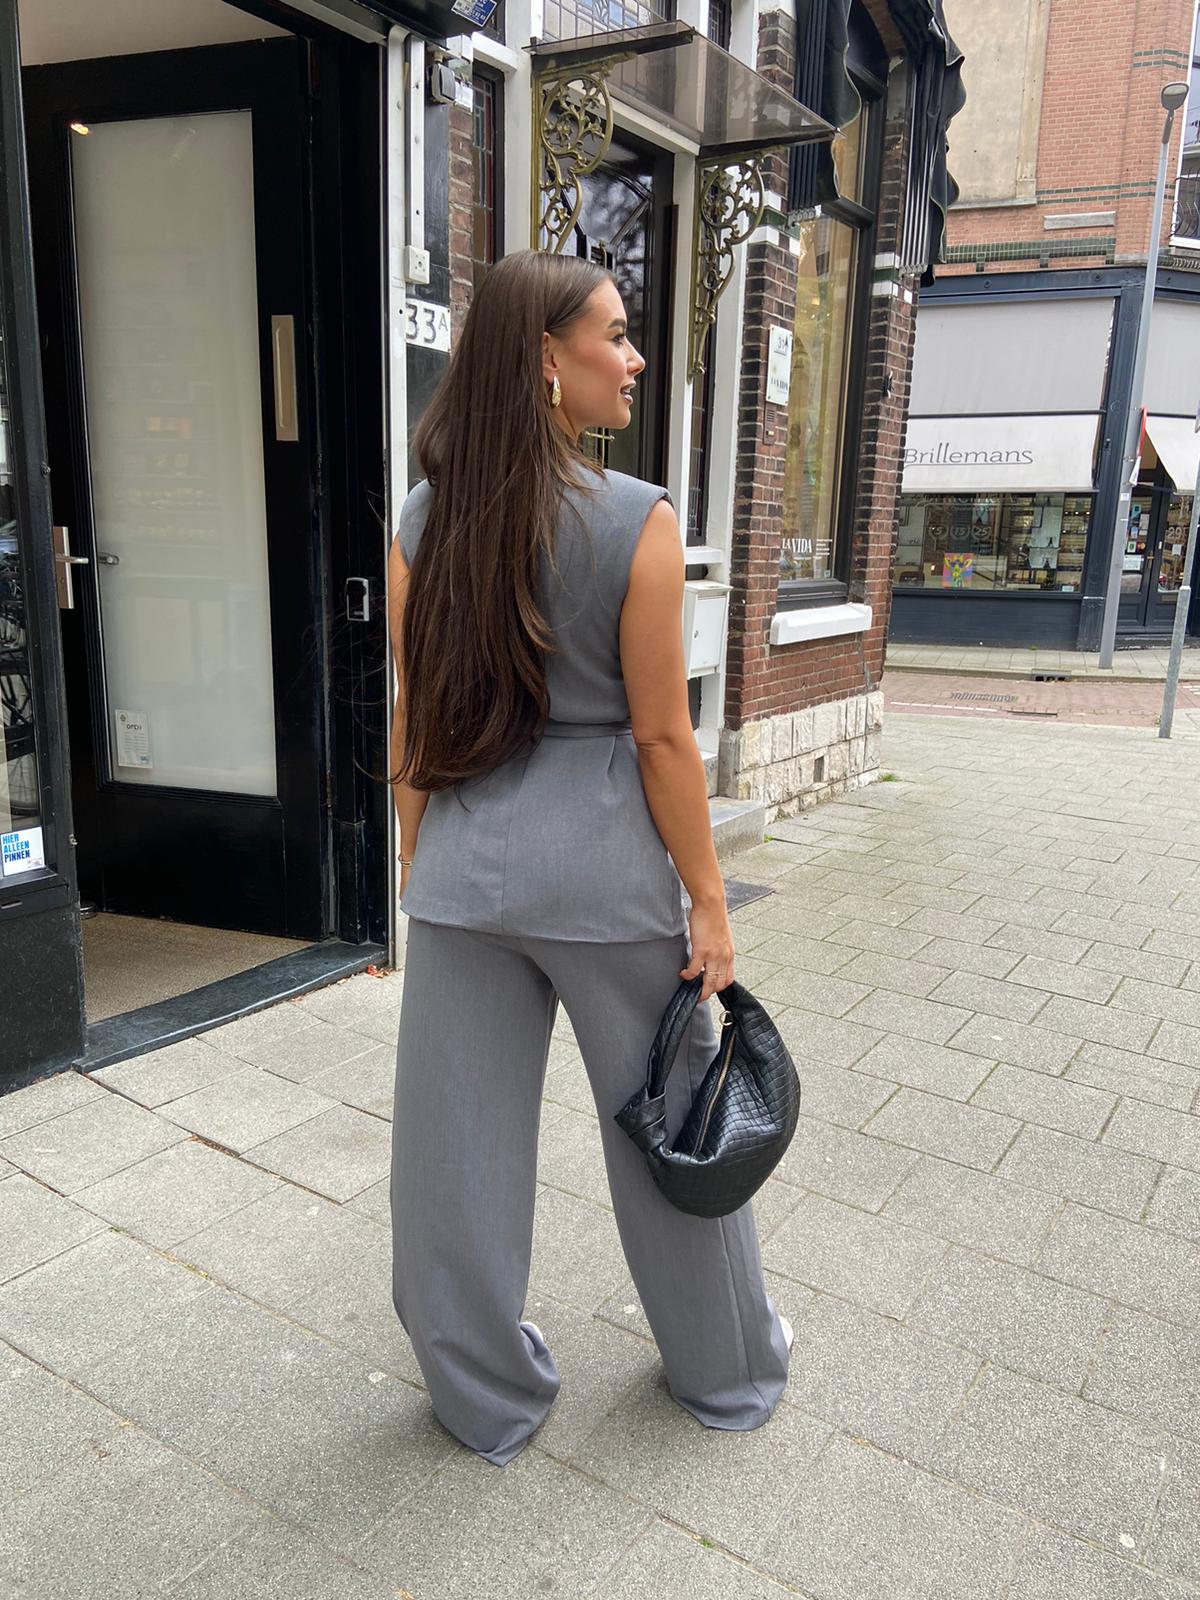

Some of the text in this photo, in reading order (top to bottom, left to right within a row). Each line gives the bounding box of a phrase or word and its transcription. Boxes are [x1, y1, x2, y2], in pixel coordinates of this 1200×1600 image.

[903, 442, 1034, 466] Brillemans
[782, 538, 793, 550] LA
[791, 538, 812, 554] VIDA
[2, 833, 20, 845] HIER
[3, 840, 30, 855] ALLEEN
[4, 848, 31, 864] PINNEN
